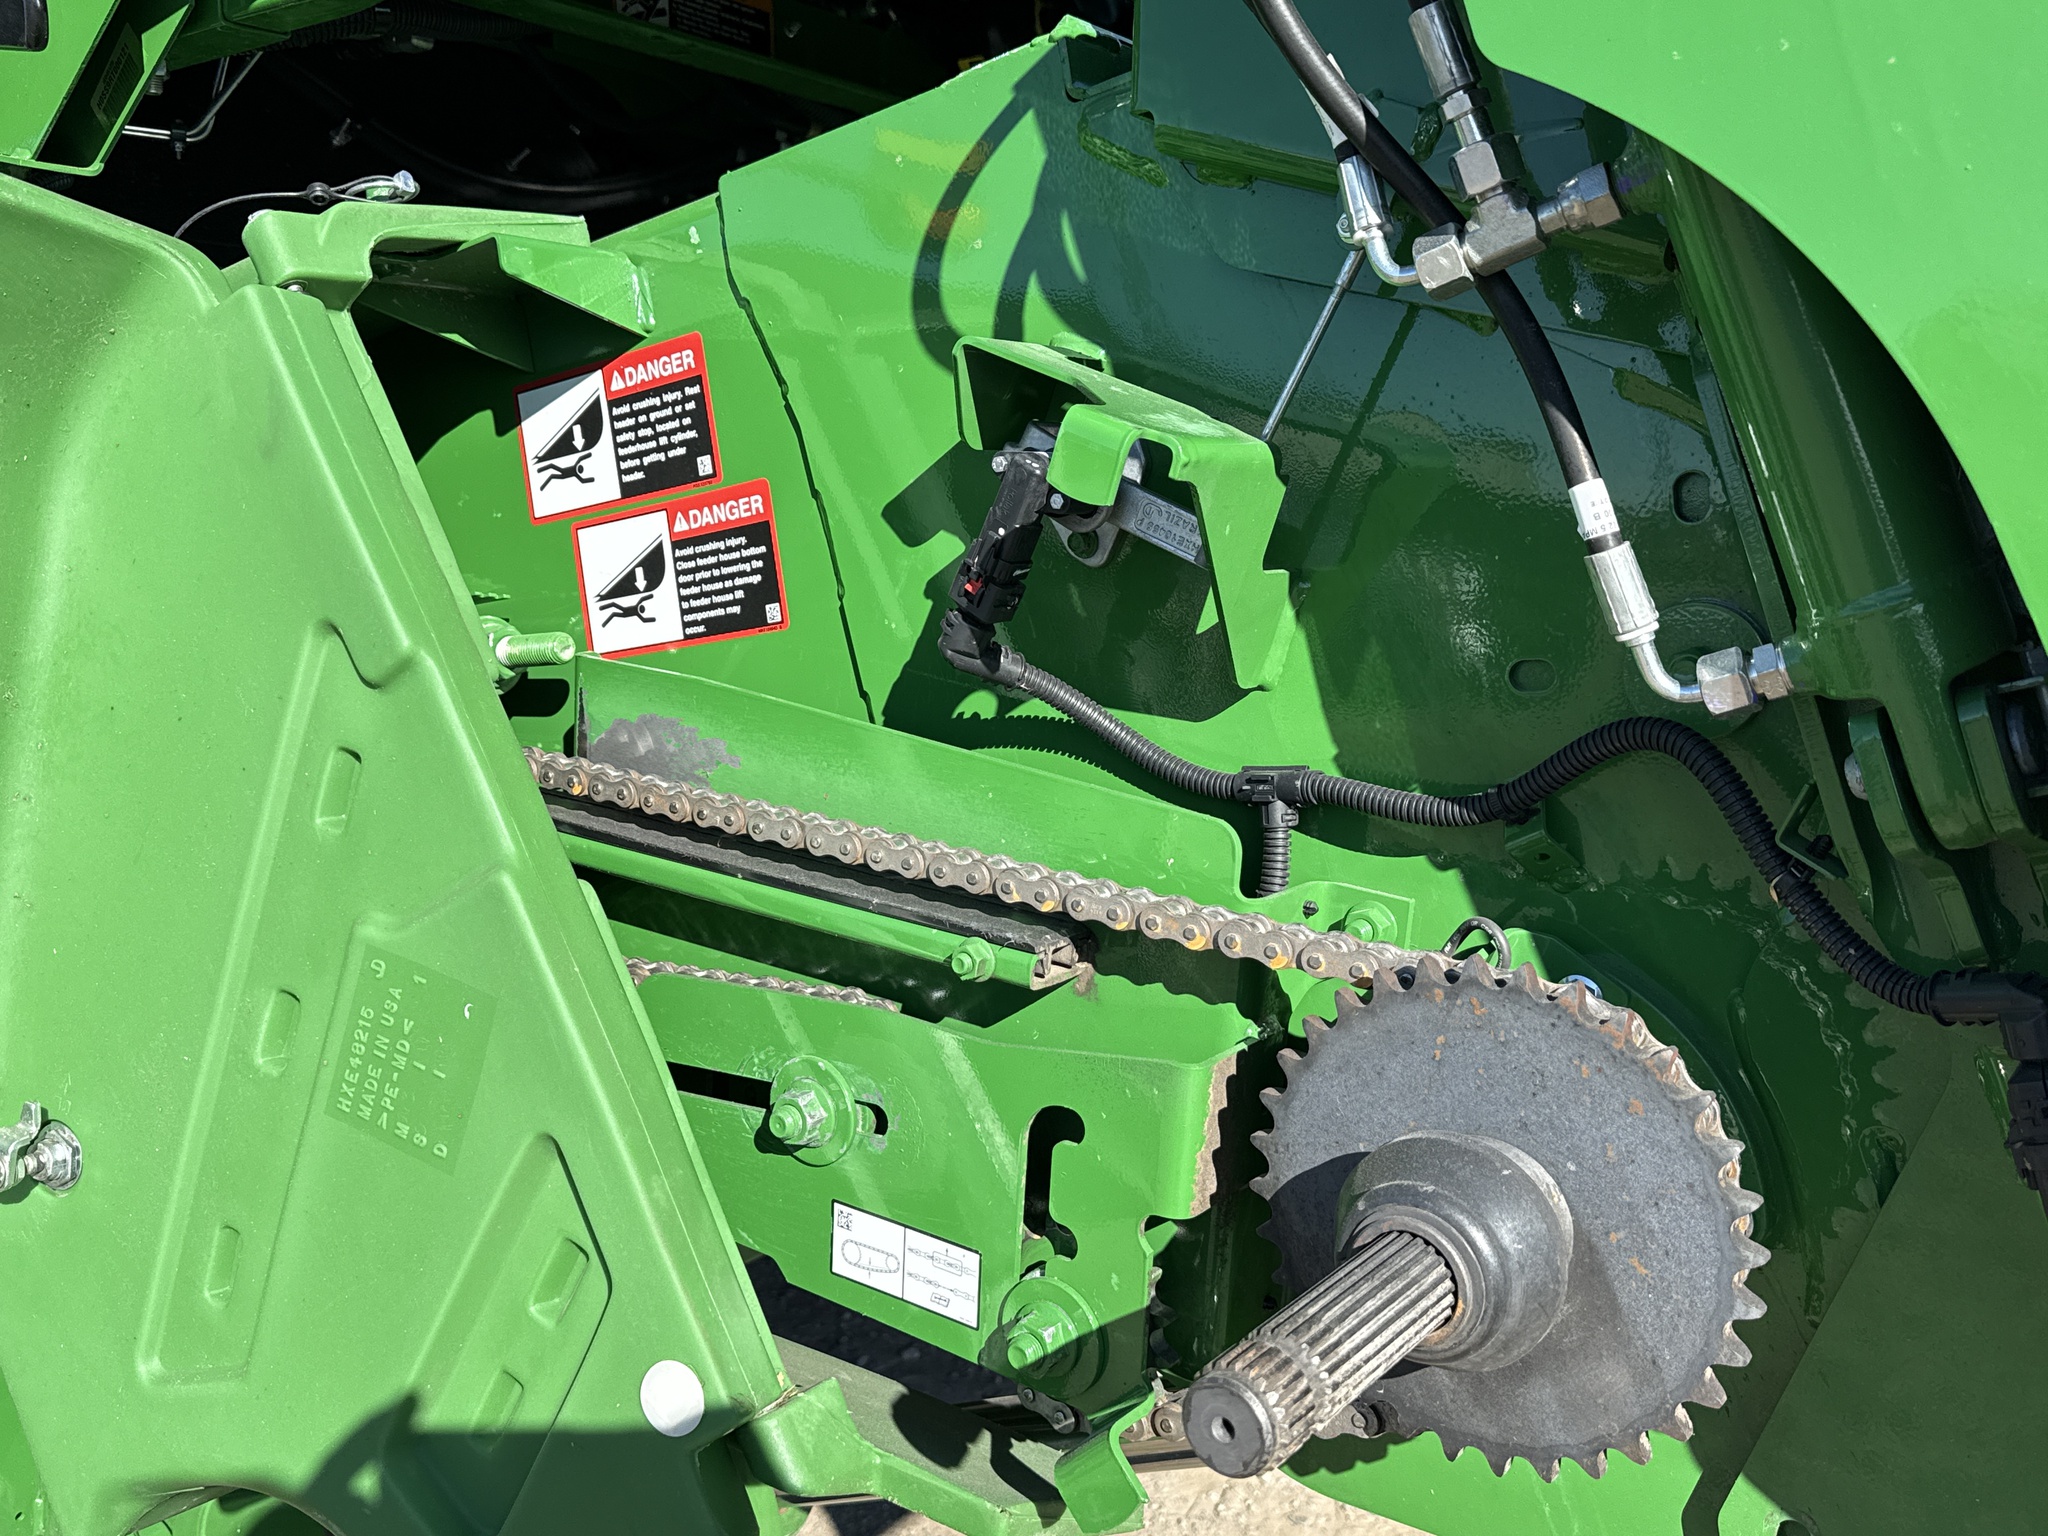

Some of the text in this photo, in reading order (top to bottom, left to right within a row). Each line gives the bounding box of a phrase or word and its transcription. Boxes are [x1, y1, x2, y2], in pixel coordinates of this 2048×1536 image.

[624, 349, 695, 387] DANGER
[612, 403, 630, 416] Avoid
[632, 396, 660, 411] crushing
[684, 384, 700, 396] Rest
[614, 400, 696, 429] header on ground or set
[616, 431, 635, 443] safety
[656, 418, 680, 432] located
[682, 417, 691, 425] on
[618, 430, 698, 456] feederhouse lift cylinder,
[620, 447, 686, 470] before getting under
[622, 471, 645, 483] header.
[689, 495, 764, 529] DANGER
[675, 536, 747, 557] Avoid crushing injury.
[676, 545, 766, 570] Close feeder house bottom
[678, 560, 763, 583] door prior to lowering the
[680, 585, 701, 596] feeder
[702, 581, 723, 591] house
[734, 574, 761, 586] damage
[681, 589, 744, 609] to feeder house lift
[683, 605, 741, 622] components may
[685, 625, 706, 635] occur.
[337, 1006, 374, 1113] HXE48215
[357, 987, 402, 1120] MADE IN USA
[394, 1122, 410, 1139] M
[413, 1133, 427, 1147] S
[433, 1143, 447, 1158] D
